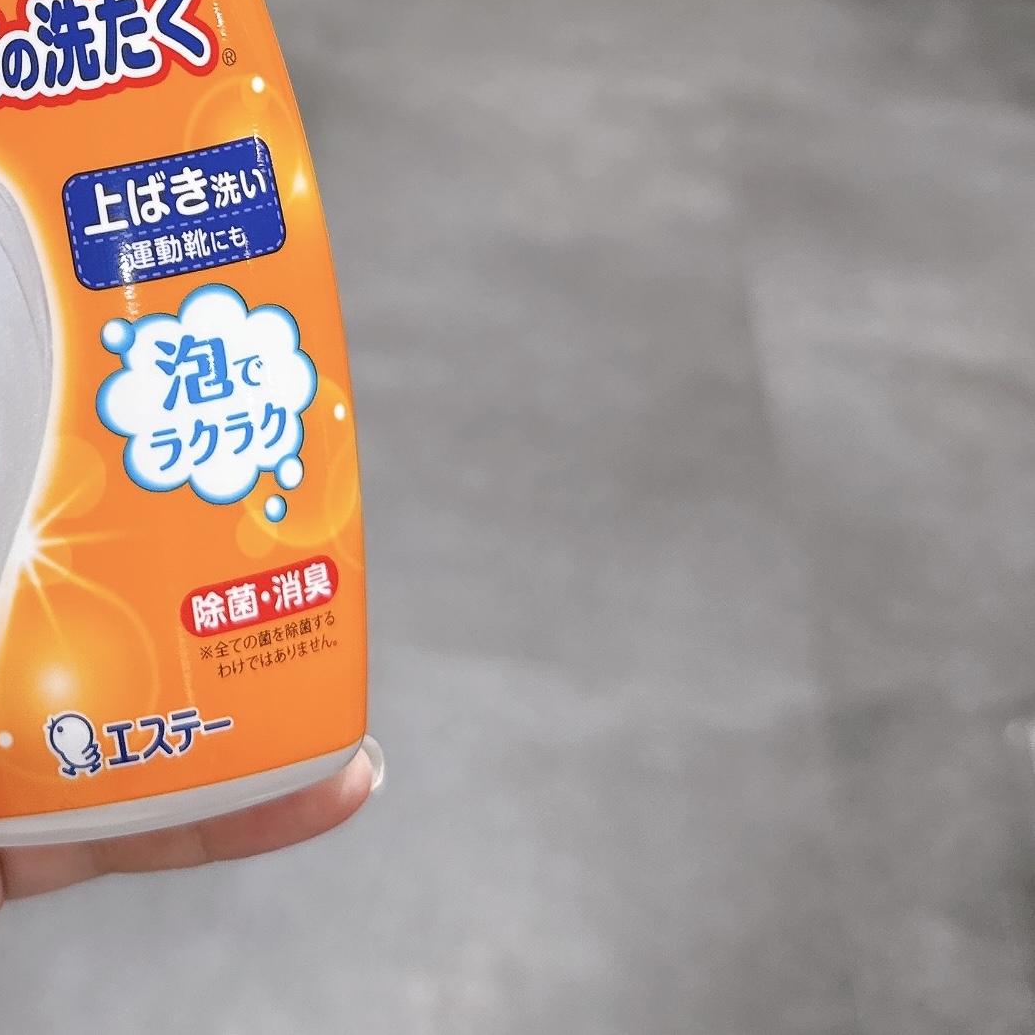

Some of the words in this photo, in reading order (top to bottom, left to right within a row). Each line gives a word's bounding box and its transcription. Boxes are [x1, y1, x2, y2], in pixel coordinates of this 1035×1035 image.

[83, 166, 267, 237] 上ばき洗い
[120, 225, 246, 271] 運動靴にも
[154, 334, 264, 411] 泡で
[150, 402, 287, 472] ラクラク
[191, 561, 332, 633] 除菌・消臭
[217, 634, 339, 679] わけではありません。
[106, 708, 232, 766] エステー
